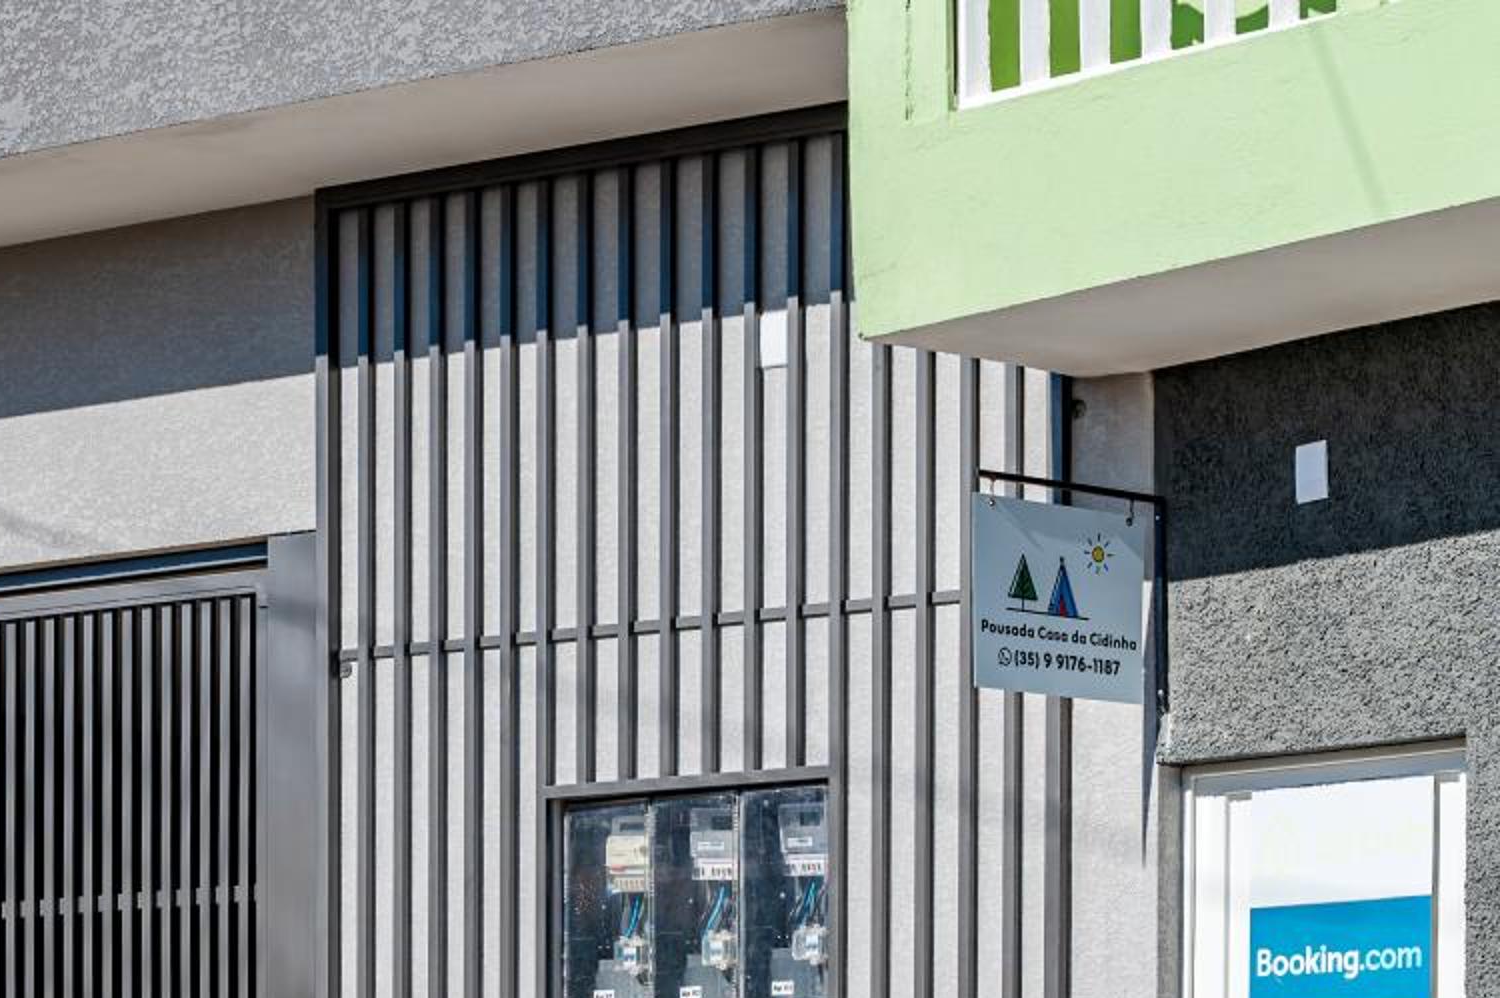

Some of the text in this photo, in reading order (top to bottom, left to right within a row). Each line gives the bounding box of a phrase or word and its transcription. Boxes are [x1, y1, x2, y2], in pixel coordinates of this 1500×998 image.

[981, 618, 1137, 651] Pousada Casa da Cidinha
[1014, 650, 1121, 675] (35) 9 9176-1187
[1256, 944, 1422, 980] Booking.com
